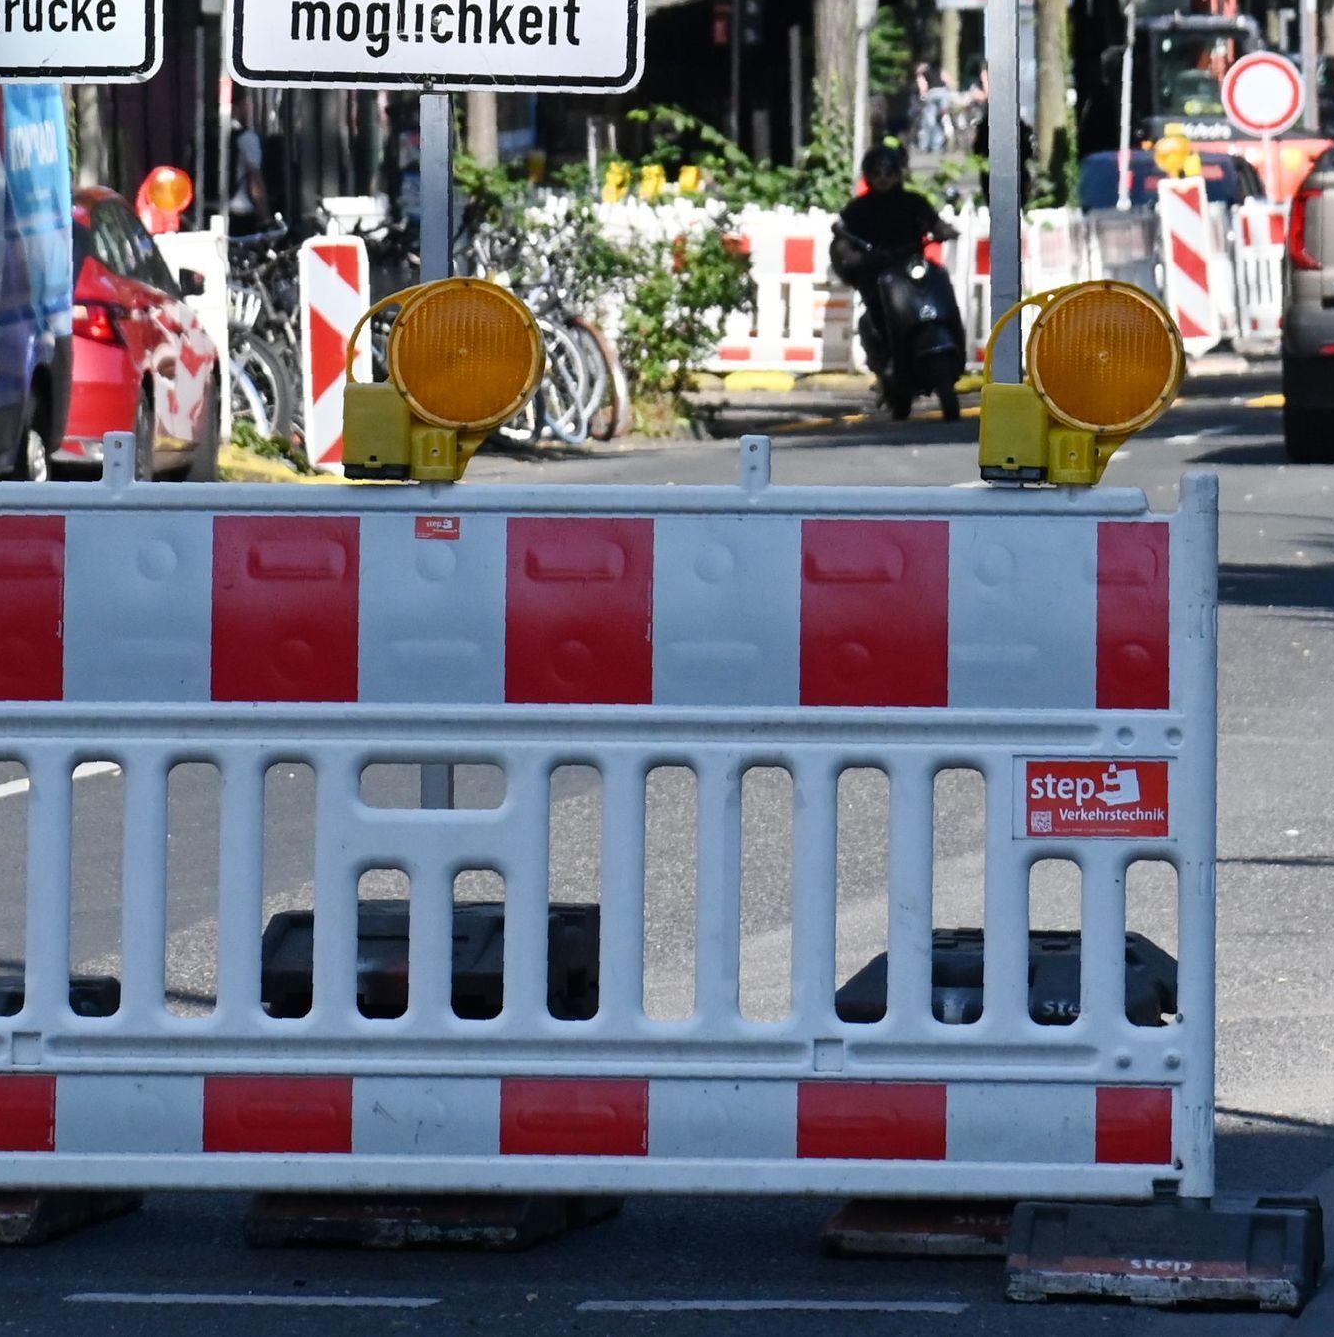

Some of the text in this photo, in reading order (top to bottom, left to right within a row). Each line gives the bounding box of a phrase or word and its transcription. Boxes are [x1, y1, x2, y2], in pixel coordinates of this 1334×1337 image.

[1030, 773, 1095, 806] step
[1059, 807, 1165, 821] Verkehrstechnik
[1042, 1000, 1081, 1017] ste
[1130, 1259, 1192, 1273] step
